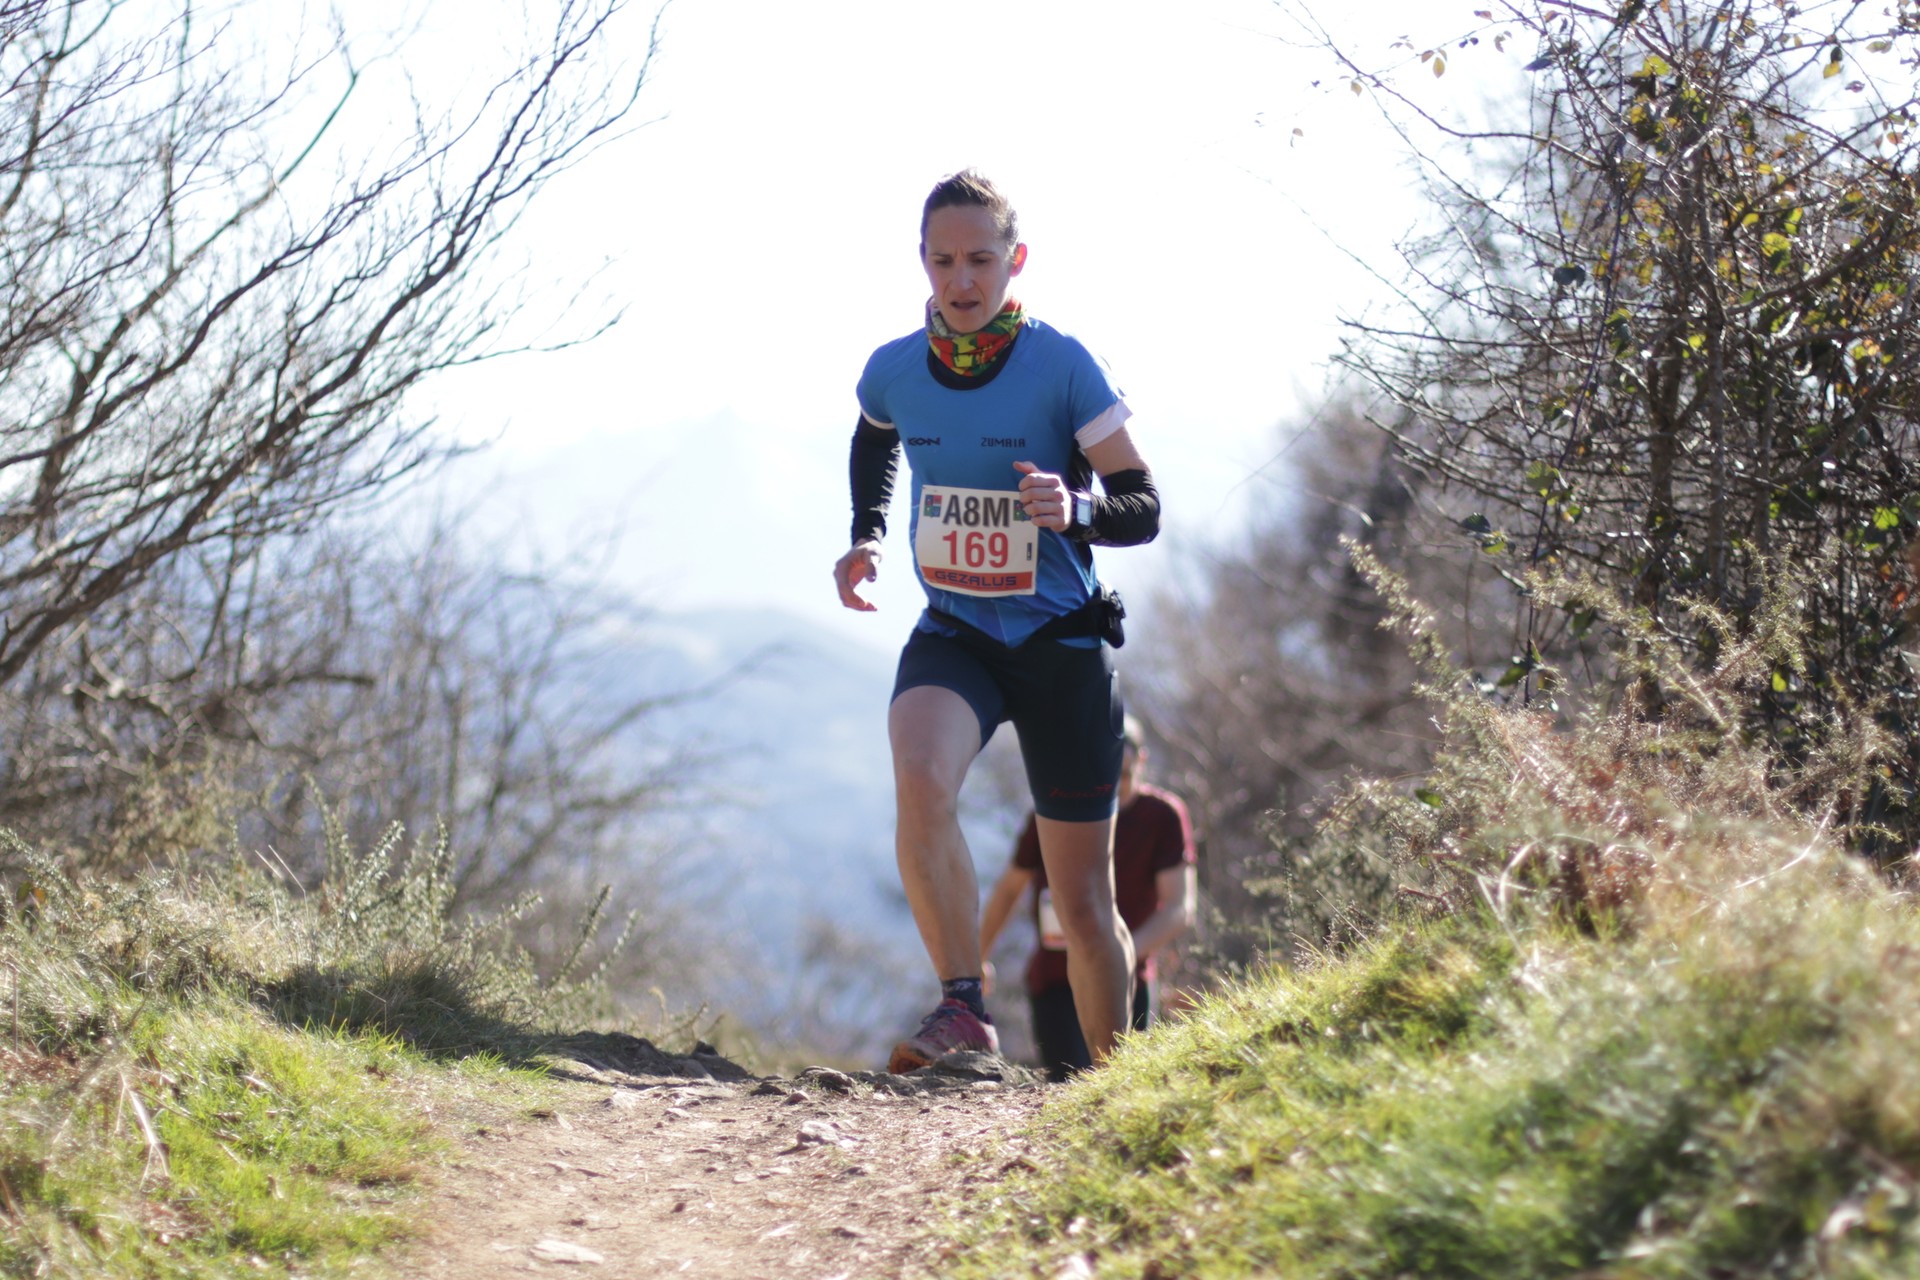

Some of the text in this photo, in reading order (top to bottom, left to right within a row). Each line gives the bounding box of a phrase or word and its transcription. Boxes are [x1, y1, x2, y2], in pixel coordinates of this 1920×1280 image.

[981, 437, 1025, 448] ZUMAIA
[942, 494, 1010, 528] A8M
[942, 530, 1009, 569] 169
[934, 570, 1017, 587] GEZALUS
